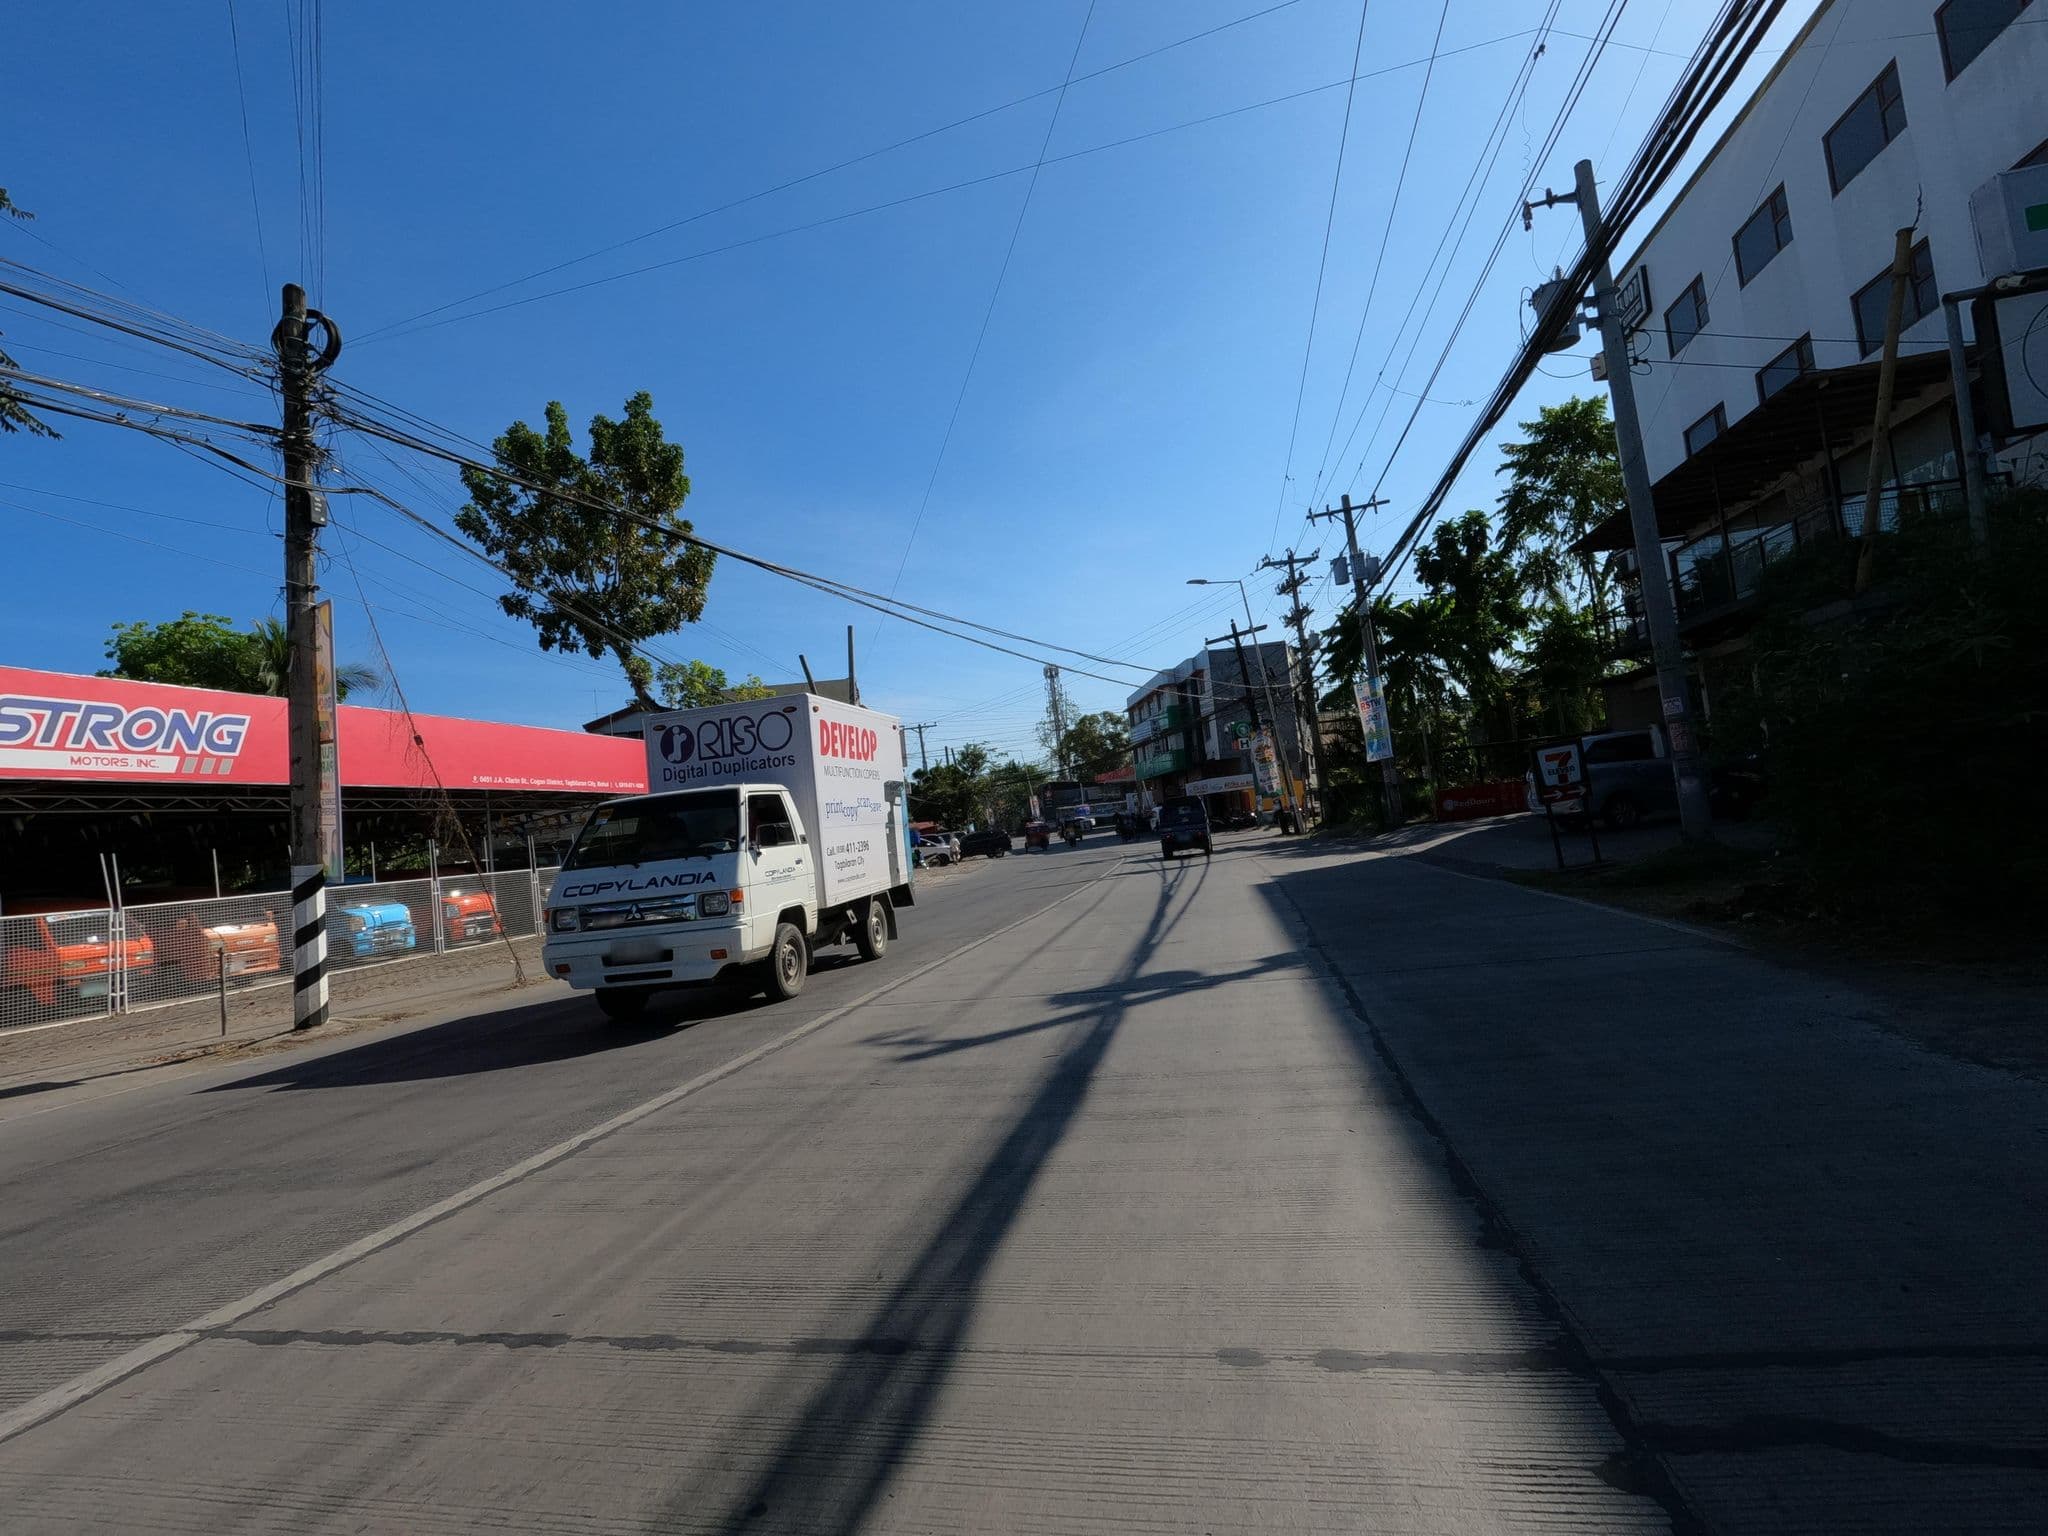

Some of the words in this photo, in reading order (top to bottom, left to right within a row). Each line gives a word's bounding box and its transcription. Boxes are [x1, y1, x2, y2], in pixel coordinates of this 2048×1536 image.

[0, 695, 251, 757] STRONG
[697, 711, 793, 761] RISO
[819, 719, 878, 761] DEVELOP
[136, 758, 160, 769] INC.
[663, 763, 707, 784] Digital
[712, 754, 796, 776] Duplicators
[823, 765, 863, 779] MULTIFUNCTION
[1545, 751, 1572, 784] 7
[562, 871, 716, 898] COPYLANDIA
